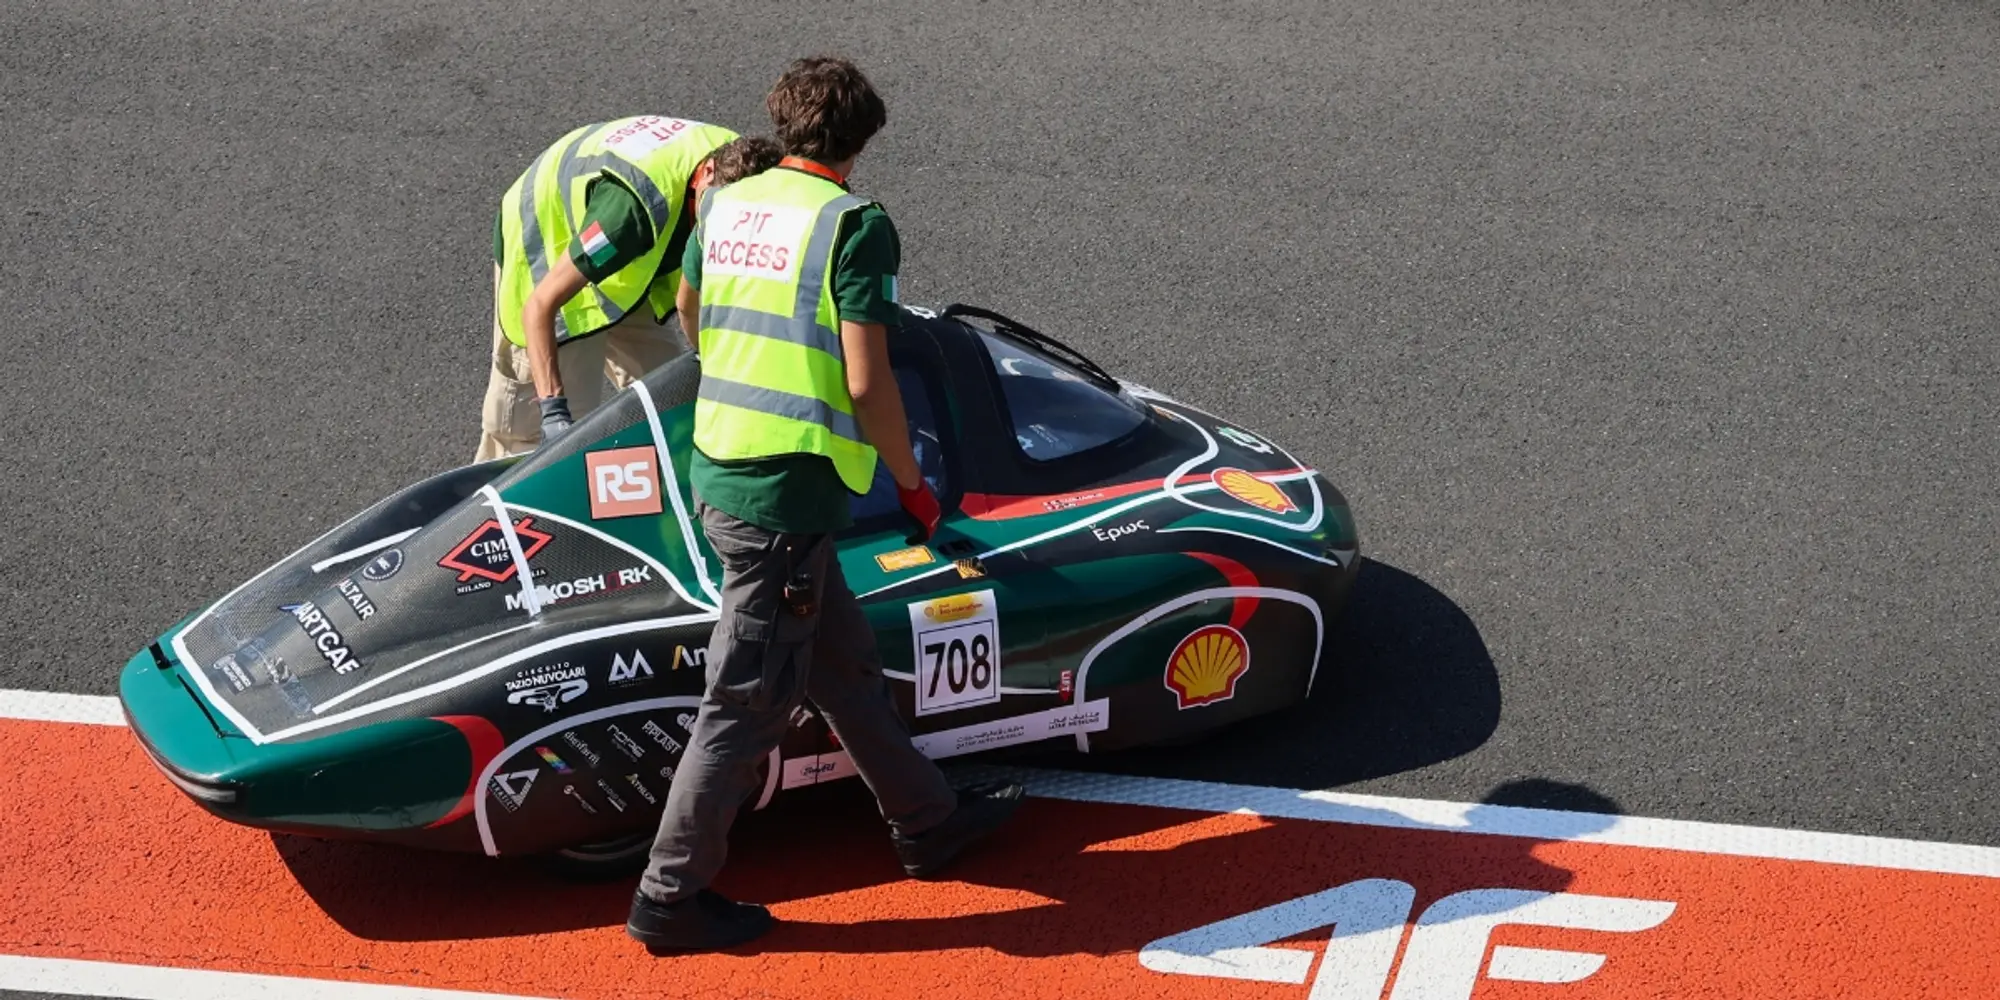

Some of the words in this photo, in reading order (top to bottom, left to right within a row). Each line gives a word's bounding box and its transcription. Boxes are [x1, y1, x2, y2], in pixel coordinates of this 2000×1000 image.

[732, 210, 773, 234] PIT
[706, 240, 789, 271] ACCESS
[594, 461, 652, 503] RS
[470, 538, 512, 557] CIM
[486, 554, 510, 565] 1915
[457, 582, 491, 594] MILANO
[925, 634, 991, 698] 708
[505, 678, 532, 691] TAZIO
[532, 666, 586, 686] NUVOLARI
